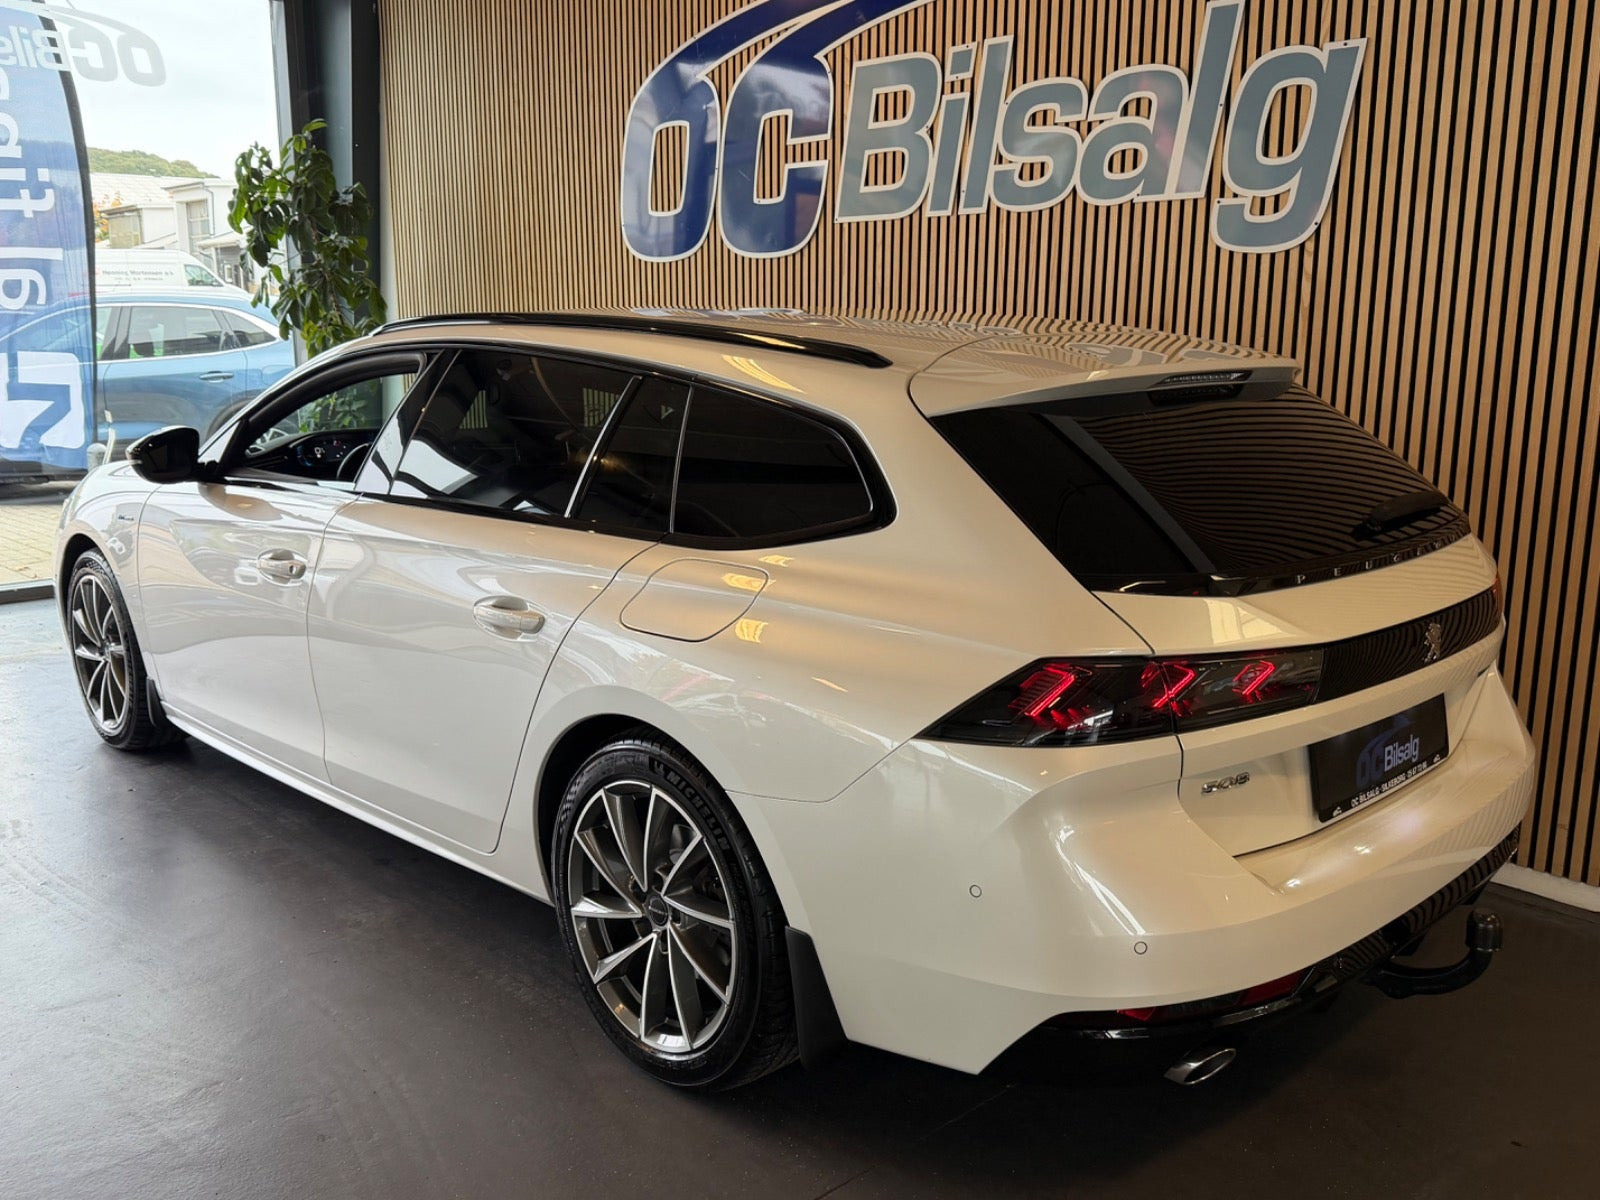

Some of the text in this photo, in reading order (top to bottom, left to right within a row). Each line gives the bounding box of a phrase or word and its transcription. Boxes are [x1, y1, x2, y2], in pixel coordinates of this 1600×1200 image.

[834, 0, 1368, 254] Bilsalg
[1296, 534, 1457, 584] PEUGEO
[1384, 734, 1420, 772] Bilsalg
[1201, 771, 1250, 794] 508
[665, 769, 731, 852] MICHELIN
